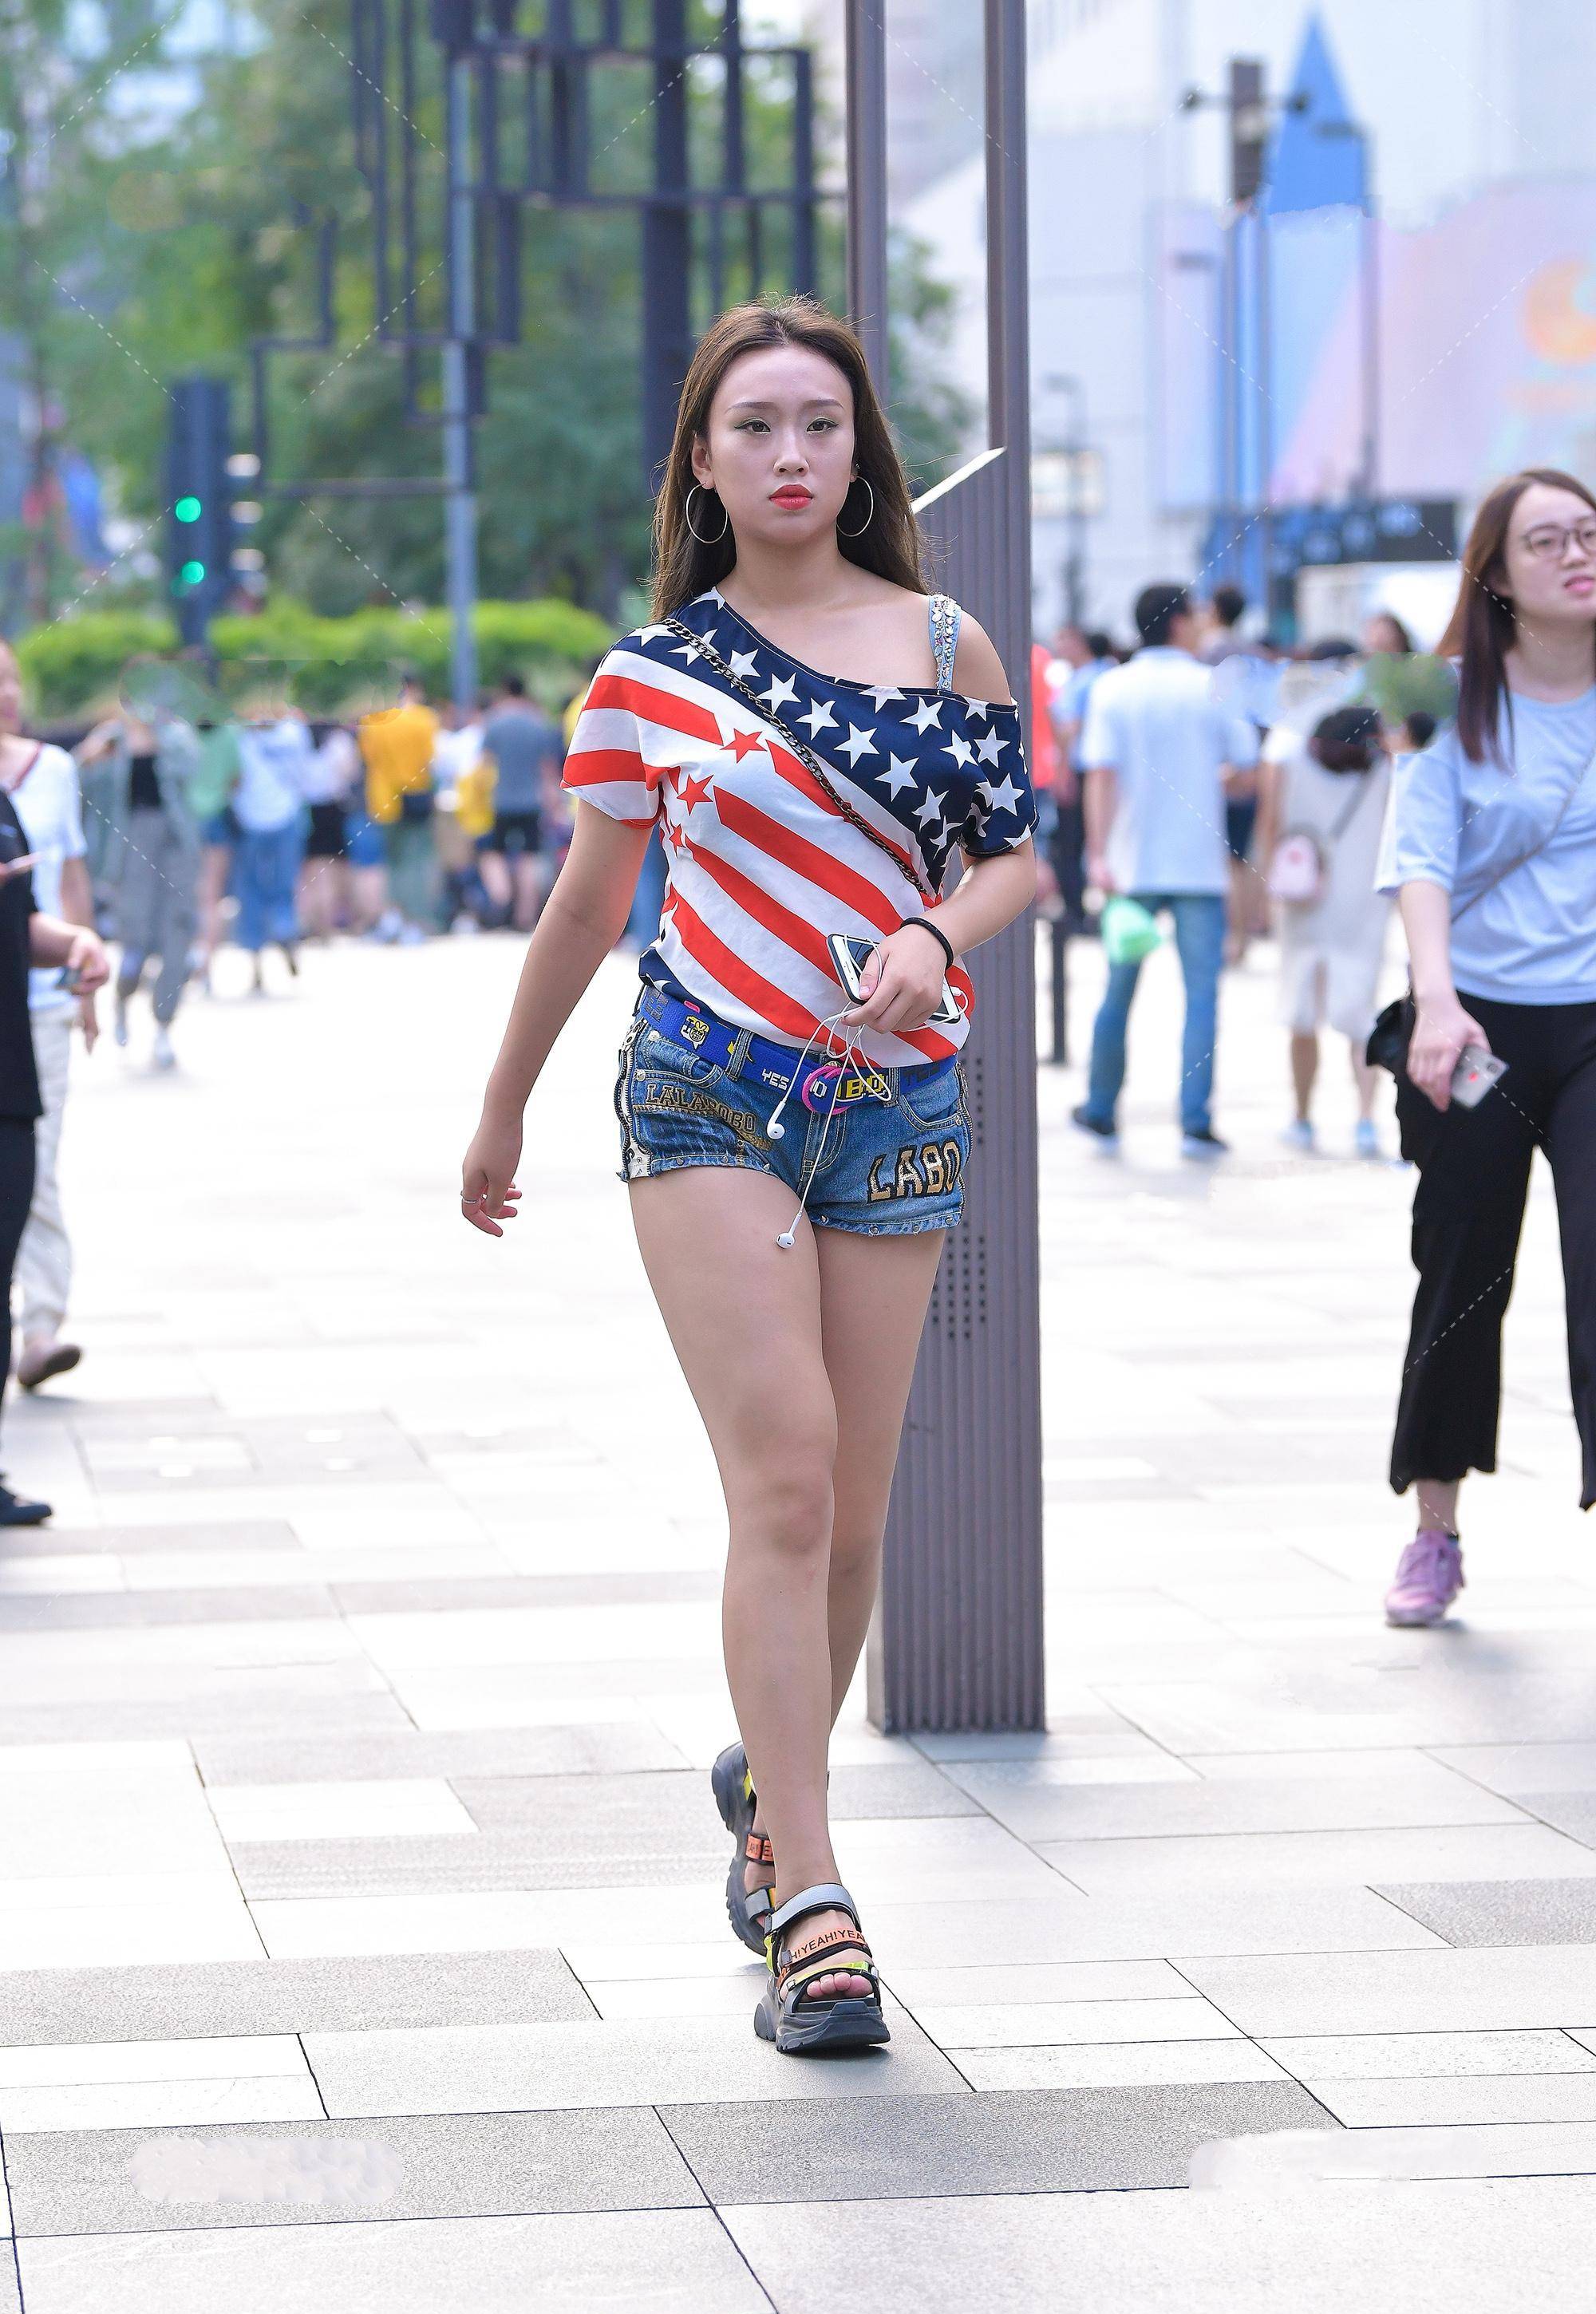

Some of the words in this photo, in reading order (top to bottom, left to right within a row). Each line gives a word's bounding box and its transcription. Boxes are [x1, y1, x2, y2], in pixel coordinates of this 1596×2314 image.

[761, 1068, 790, 1091] YES
[836, 1074, 885, 1098] BO
[867, 1138, 961, 1203] LABO
